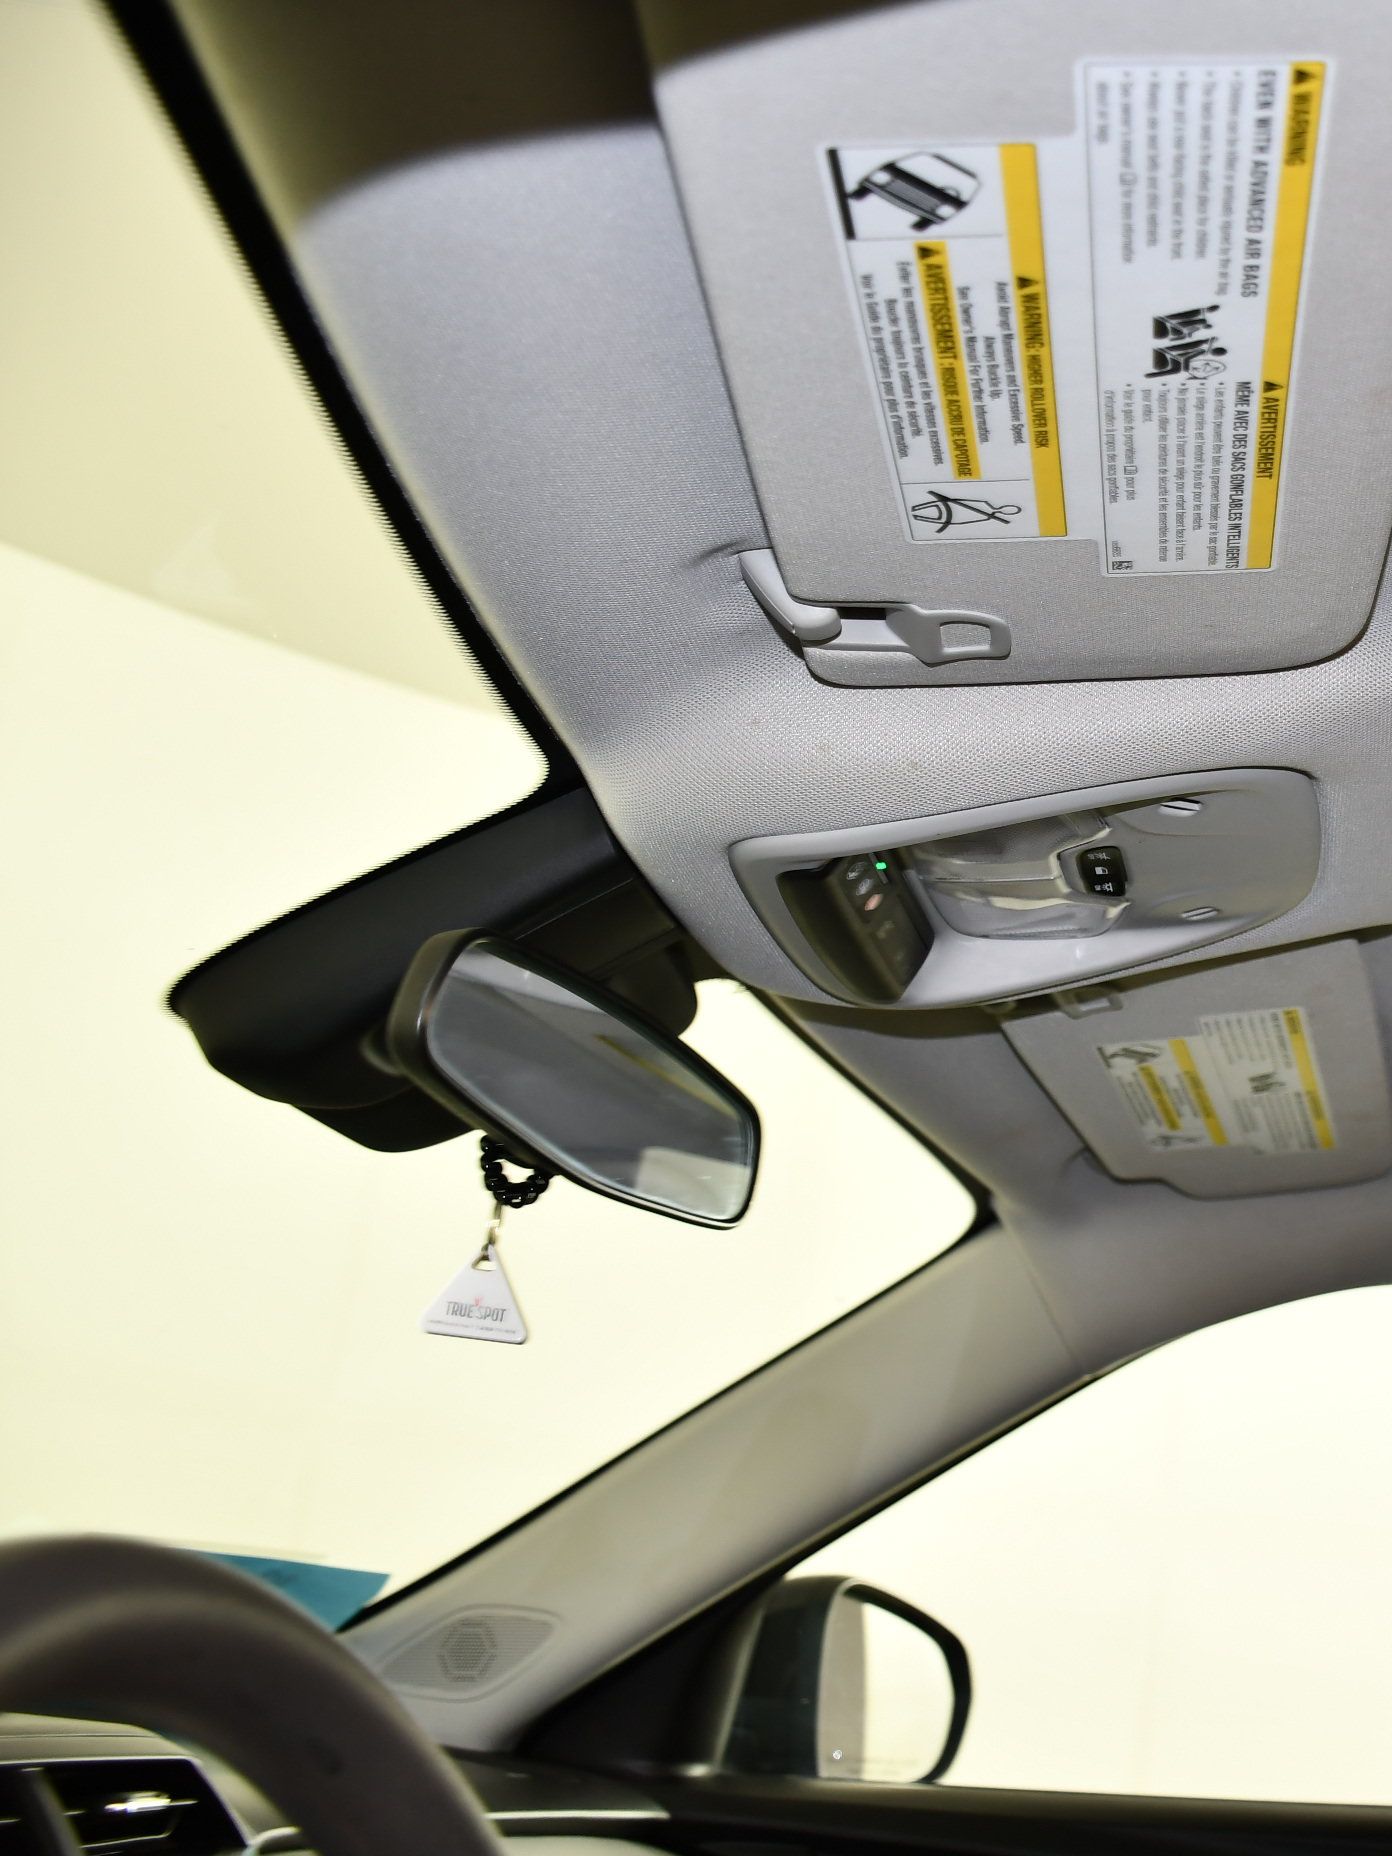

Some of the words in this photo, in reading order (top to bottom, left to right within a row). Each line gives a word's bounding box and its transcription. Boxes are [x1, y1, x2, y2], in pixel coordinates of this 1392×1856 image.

[1253, 116, 1273, 153] WITH
[1245, 158, 1269, 233] ADVANCED
[1243, 238, 1262, 259] AIR
[1240, 264, 1260, 297] BAGS
[922, 263, 957, 359] AVERTISSEMENT
[1019, 292, 1045, 352] WARNING:
[939, 367, 959, 395] RISQUE
[1234, 381, 1255, 407] MÊME
[945, 398, 964, 425] ACCRU
[1007, 389, 1023, 422] Excessive
[1029, 387, 1047, 428] ROLLOVER
[1233, 410, 1249, 431] AVEC
[950, 427, 966, 436] DE
[1008, 423, 1026, 446] Speed.
[1033, 429, 1049, 448] RISK
[1232, 433, 1248, 449] DES
[1256, 396, 1279, 479] AVERTISSEMENT
[952, 438, 972, 476] CAPOTAGE
[1230, 451, 1246, 472] SACS
[1227, 473, 1245, 521] GONFLABLES
[1225, 522, 1241, 568] INTELLIGENTS
[446, 1301, 473, 1318] TRUE
[475, 1306, 506, 1322] SPOT
